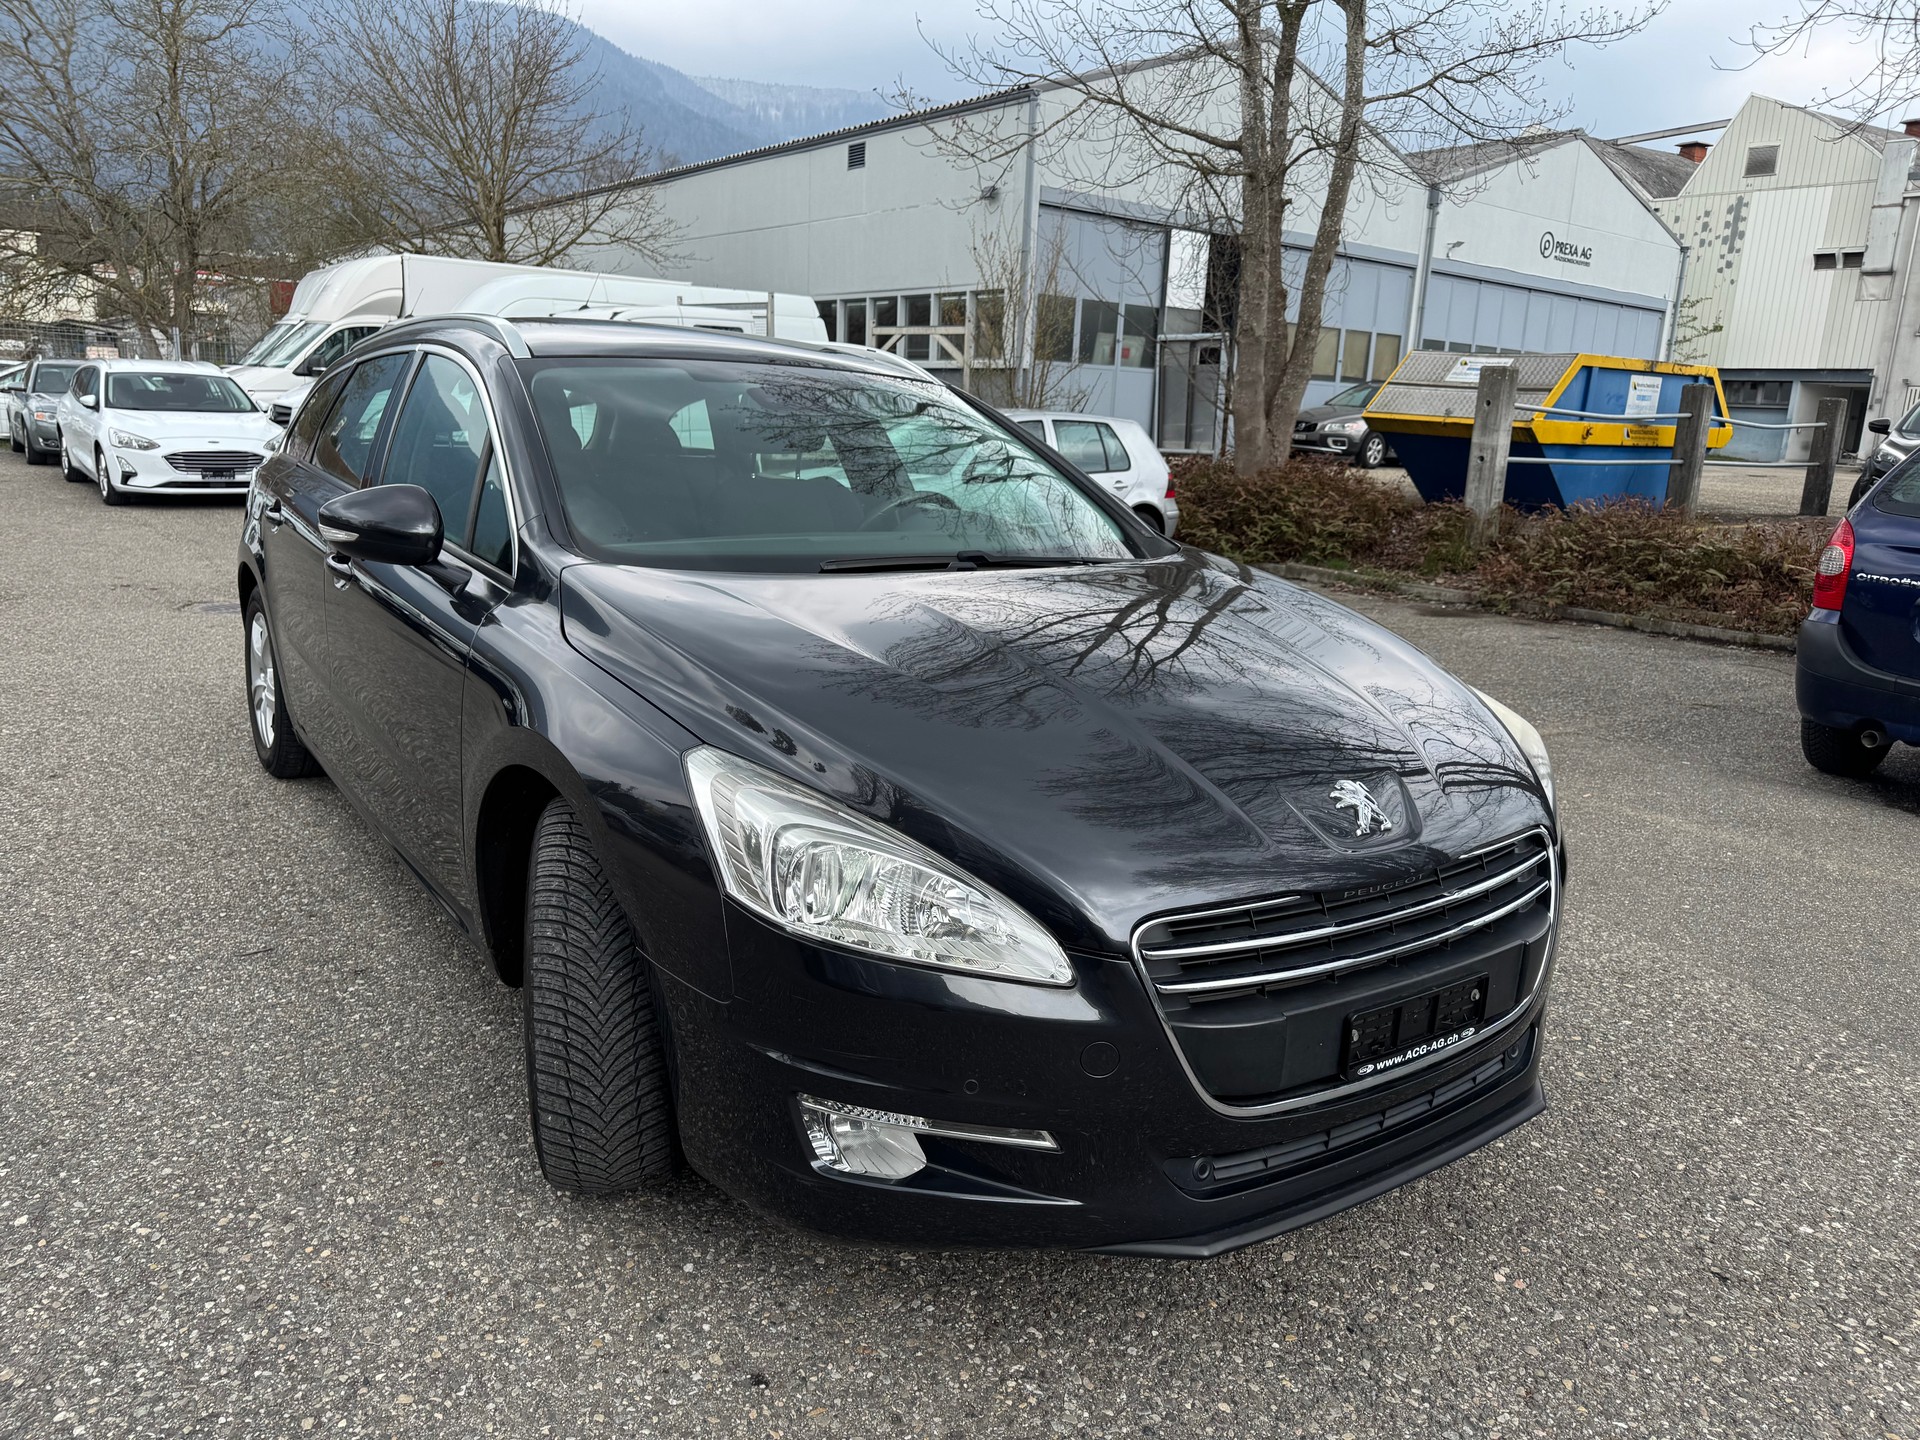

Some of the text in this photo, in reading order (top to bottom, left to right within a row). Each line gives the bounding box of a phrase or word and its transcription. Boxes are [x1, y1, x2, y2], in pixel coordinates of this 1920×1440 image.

[1555, 241, 1592, 260] PREXA AG
[1343, 873, 1424, 898] PEUGEOT
[1376, 1033, 1459, 1070] www.ACG-AG.ch
